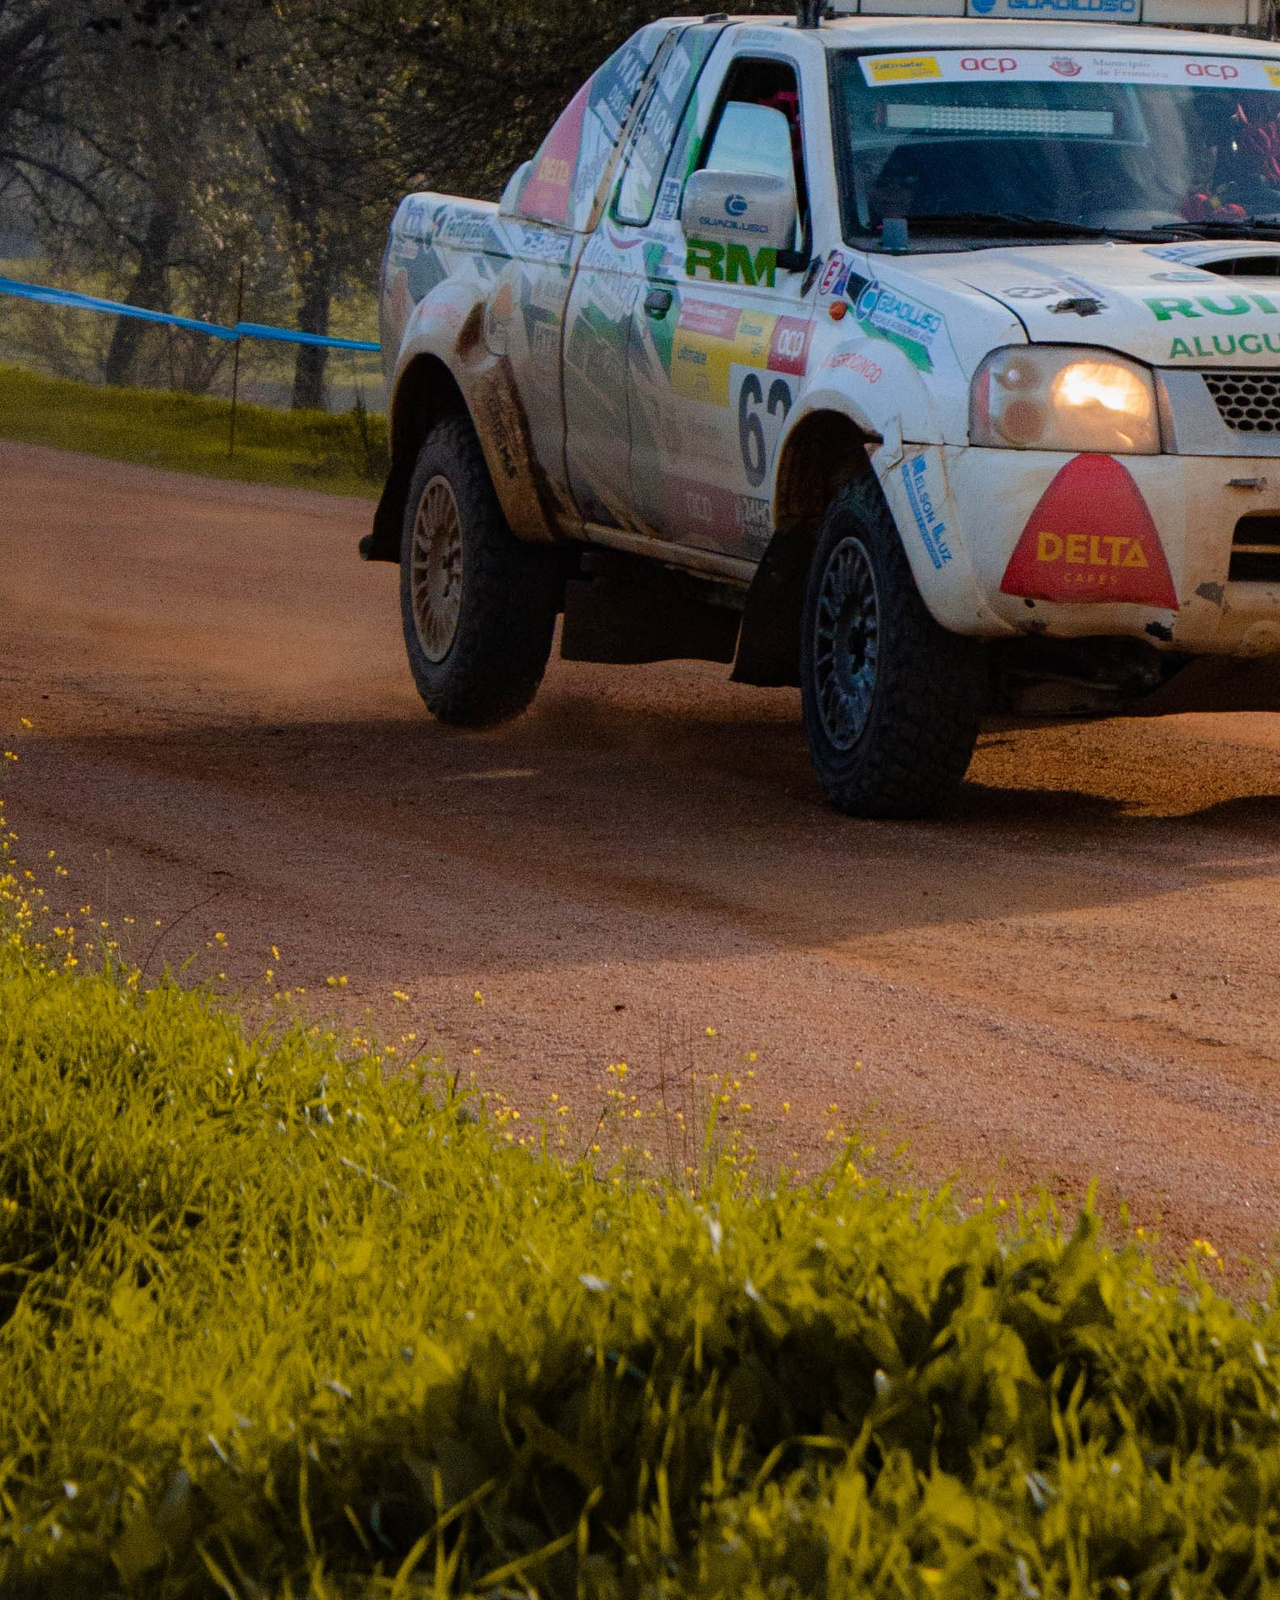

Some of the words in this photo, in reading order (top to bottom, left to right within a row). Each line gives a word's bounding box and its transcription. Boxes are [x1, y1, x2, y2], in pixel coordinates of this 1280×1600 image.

[960, 57, 1018, 73] acp
[1185, 63, 1239, 81] acp
[686, 237, 777, 288] RM
[1142, 293, 1279, 322] RUI
[1036, 531, 1149, 568] DELTA
